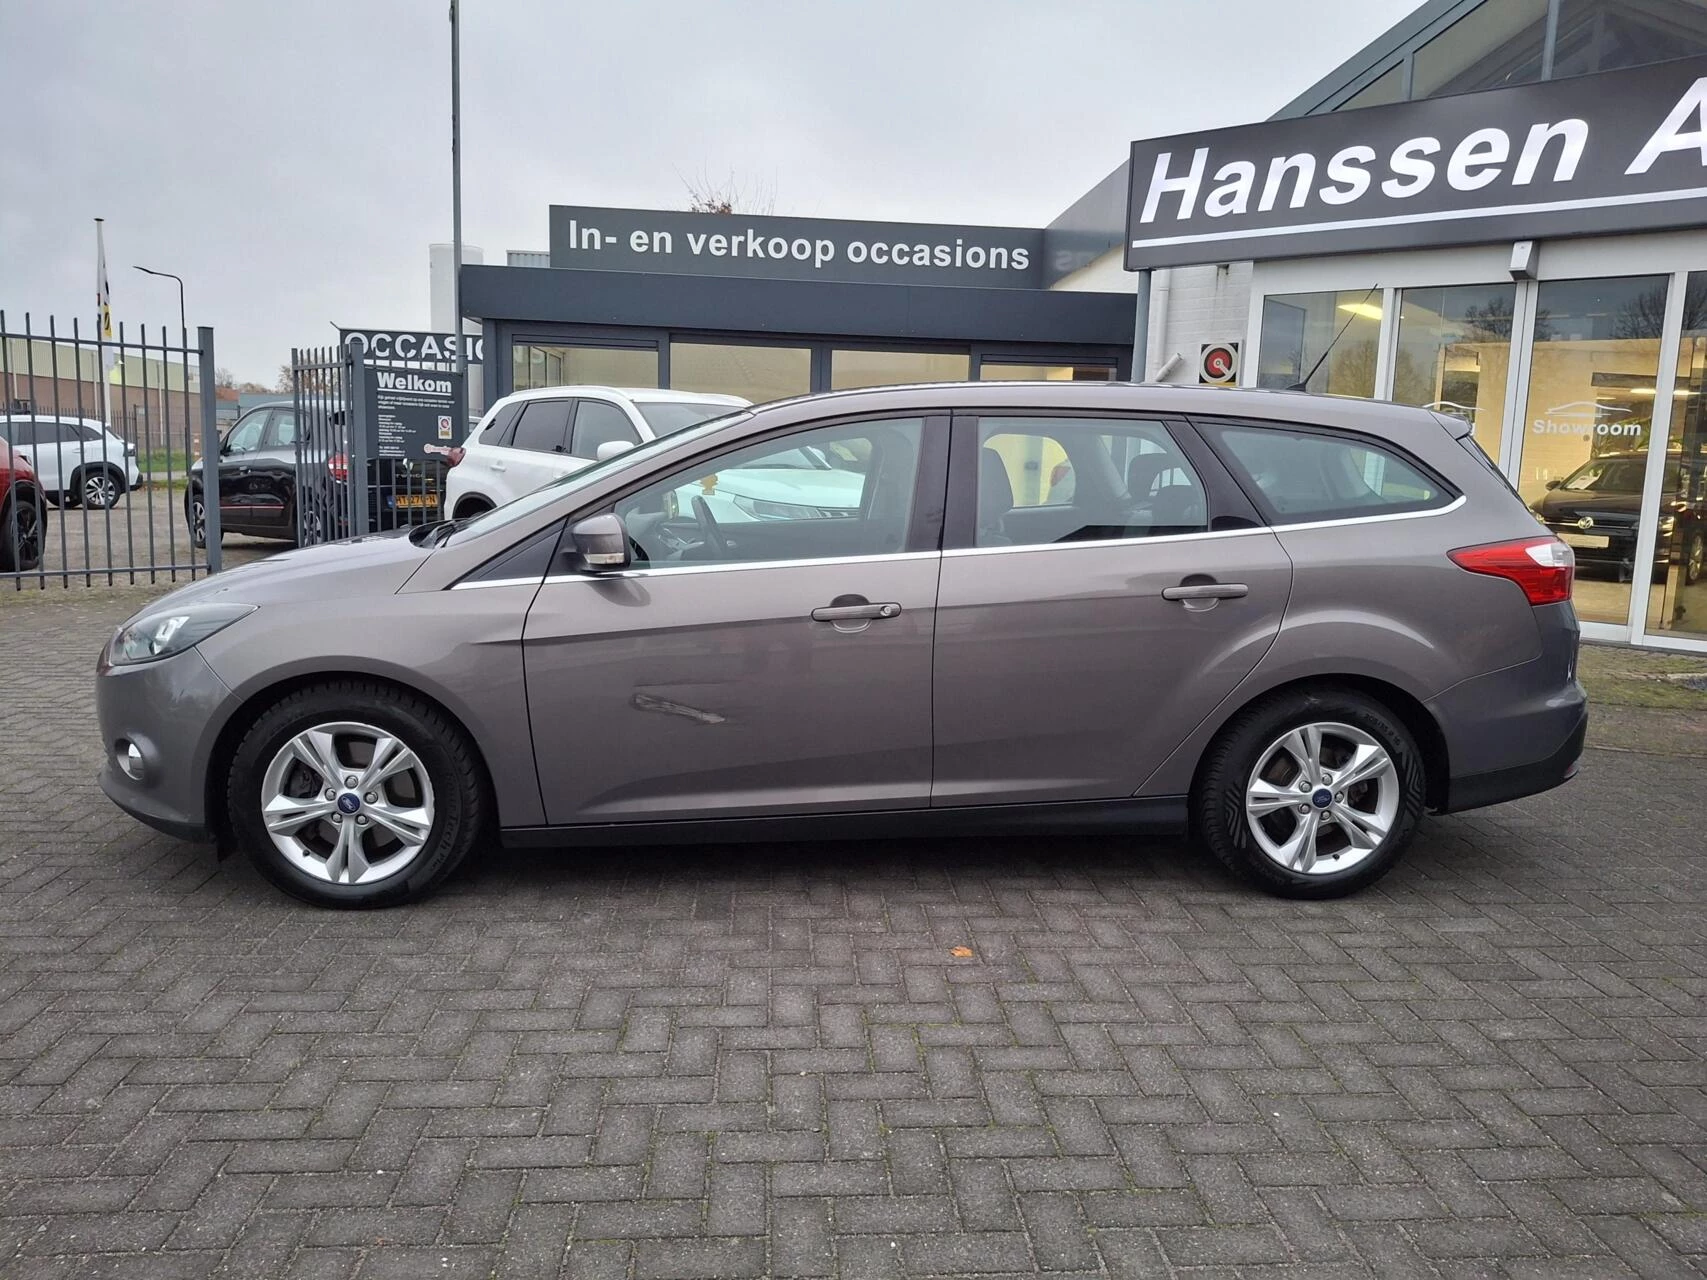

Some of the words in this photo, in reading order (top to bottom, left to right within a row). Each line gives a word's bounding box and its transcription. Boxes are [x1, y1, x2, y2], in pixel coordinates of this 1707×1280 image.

[1139, 117, 1589, 223] Hanssen
[569, 219, 616, 250] In-
[629, 230, 673, 254] en
[686, 229, 835, 269] verkoop
[846, 238, 1029, 270] occasions
[376, 371, 452, 393] Welkom
[1532, 419, 1641, 436] Showroom
